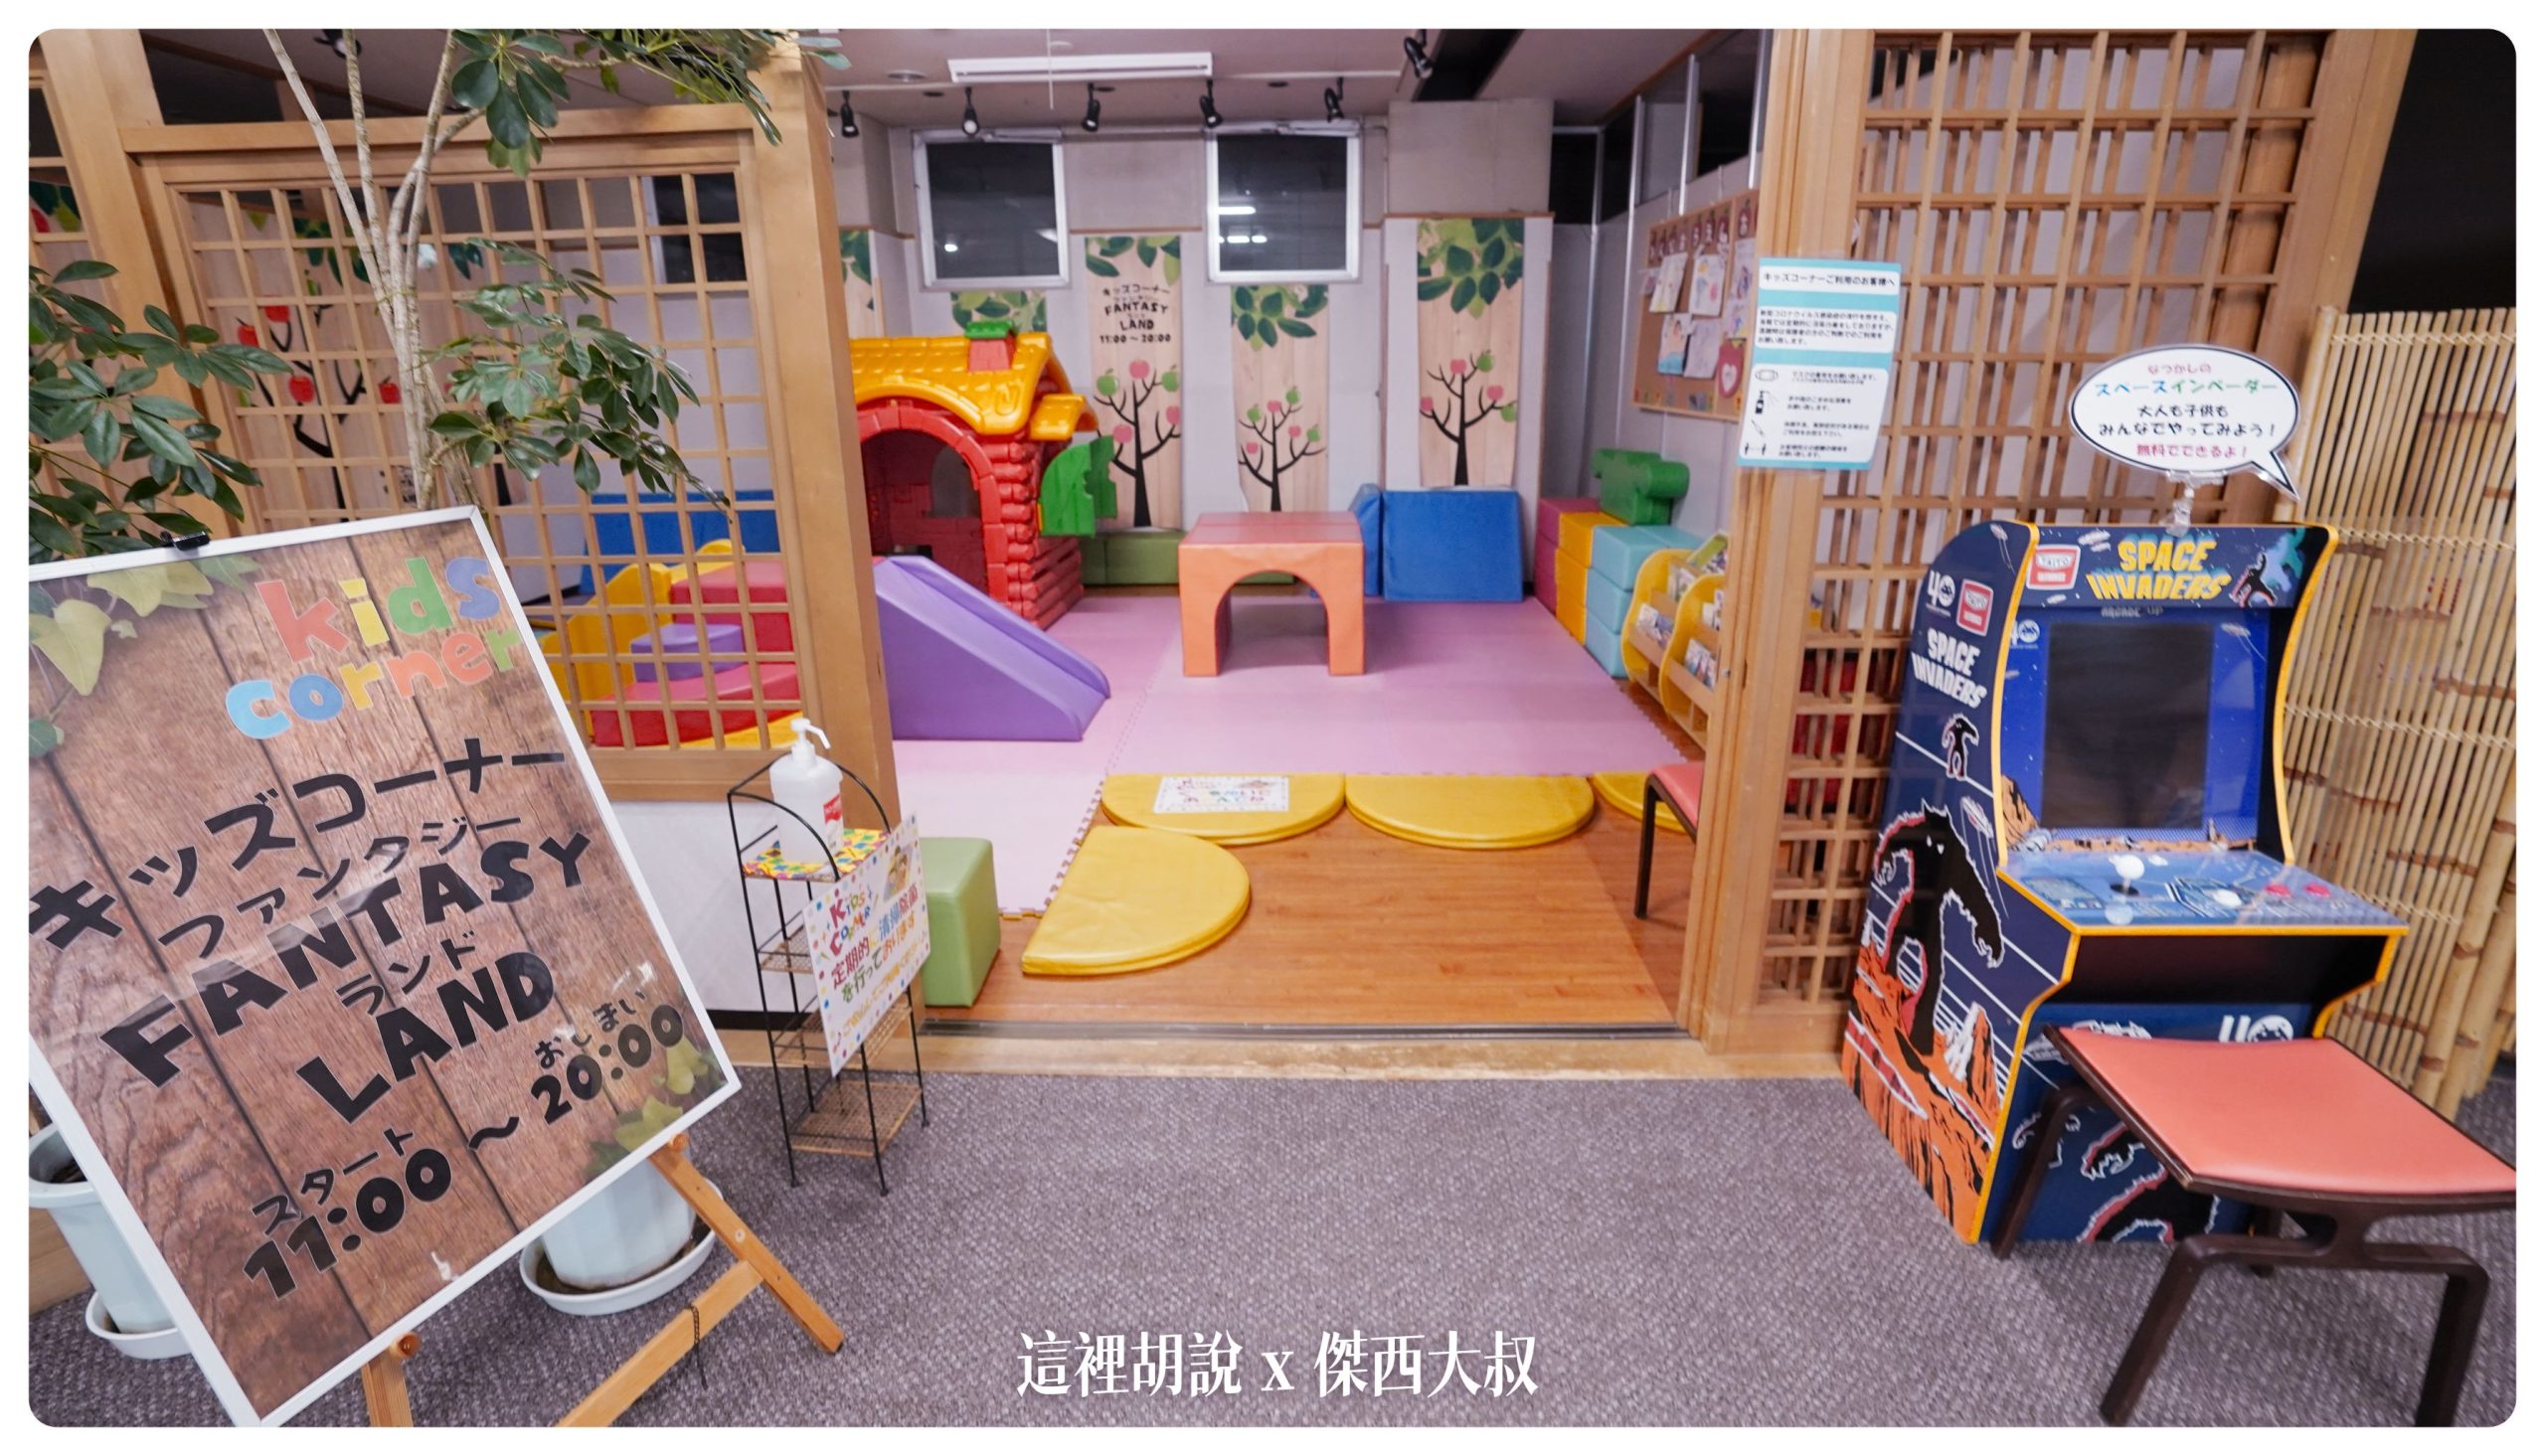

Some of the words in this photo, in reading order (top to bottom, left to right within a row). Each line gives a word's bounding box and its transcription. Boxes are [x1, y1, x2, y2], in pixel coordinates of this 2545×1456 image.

[1104, 301, 1169, 316] FANTASY
[1119, 319, 1154, 331] LAND
[2095, 379, 2278, 397] スペースインベーダー
[2147, 364, 2212, 375] なつかしの
[2099, 422, 2276, 437] みんなでやってみよう！
[2136, 404, 2229, 417] 大人も子供も
[2136, 443, 2248, 458] 無料でできるよ！
[2118, 538, 2218, 572] SPACE
[254, 556, 501, 663] kids
[2086, 571, 2233, 600] INVADERS
[1911, 651, 1988, 709] INVADERS
[1927, 627, 1981, 677] SPACE
[225, 625, 520, 740] corner
[29, 737, 566, 951] キッズコーナー
[158, 816, 521, 958] ファンタジー
[100, 832, 591, 1088] FANTASY
[335, 929, 477, 1015] ランド
[297, 951, 554, 1124] LAND
[536, 990, 647, 1068] おしまい
[243, 1148, 452, 1300] 11:00
[531, 1004, 684, 1125] 20:00
[252, 1127, 415, 1236] スタート
